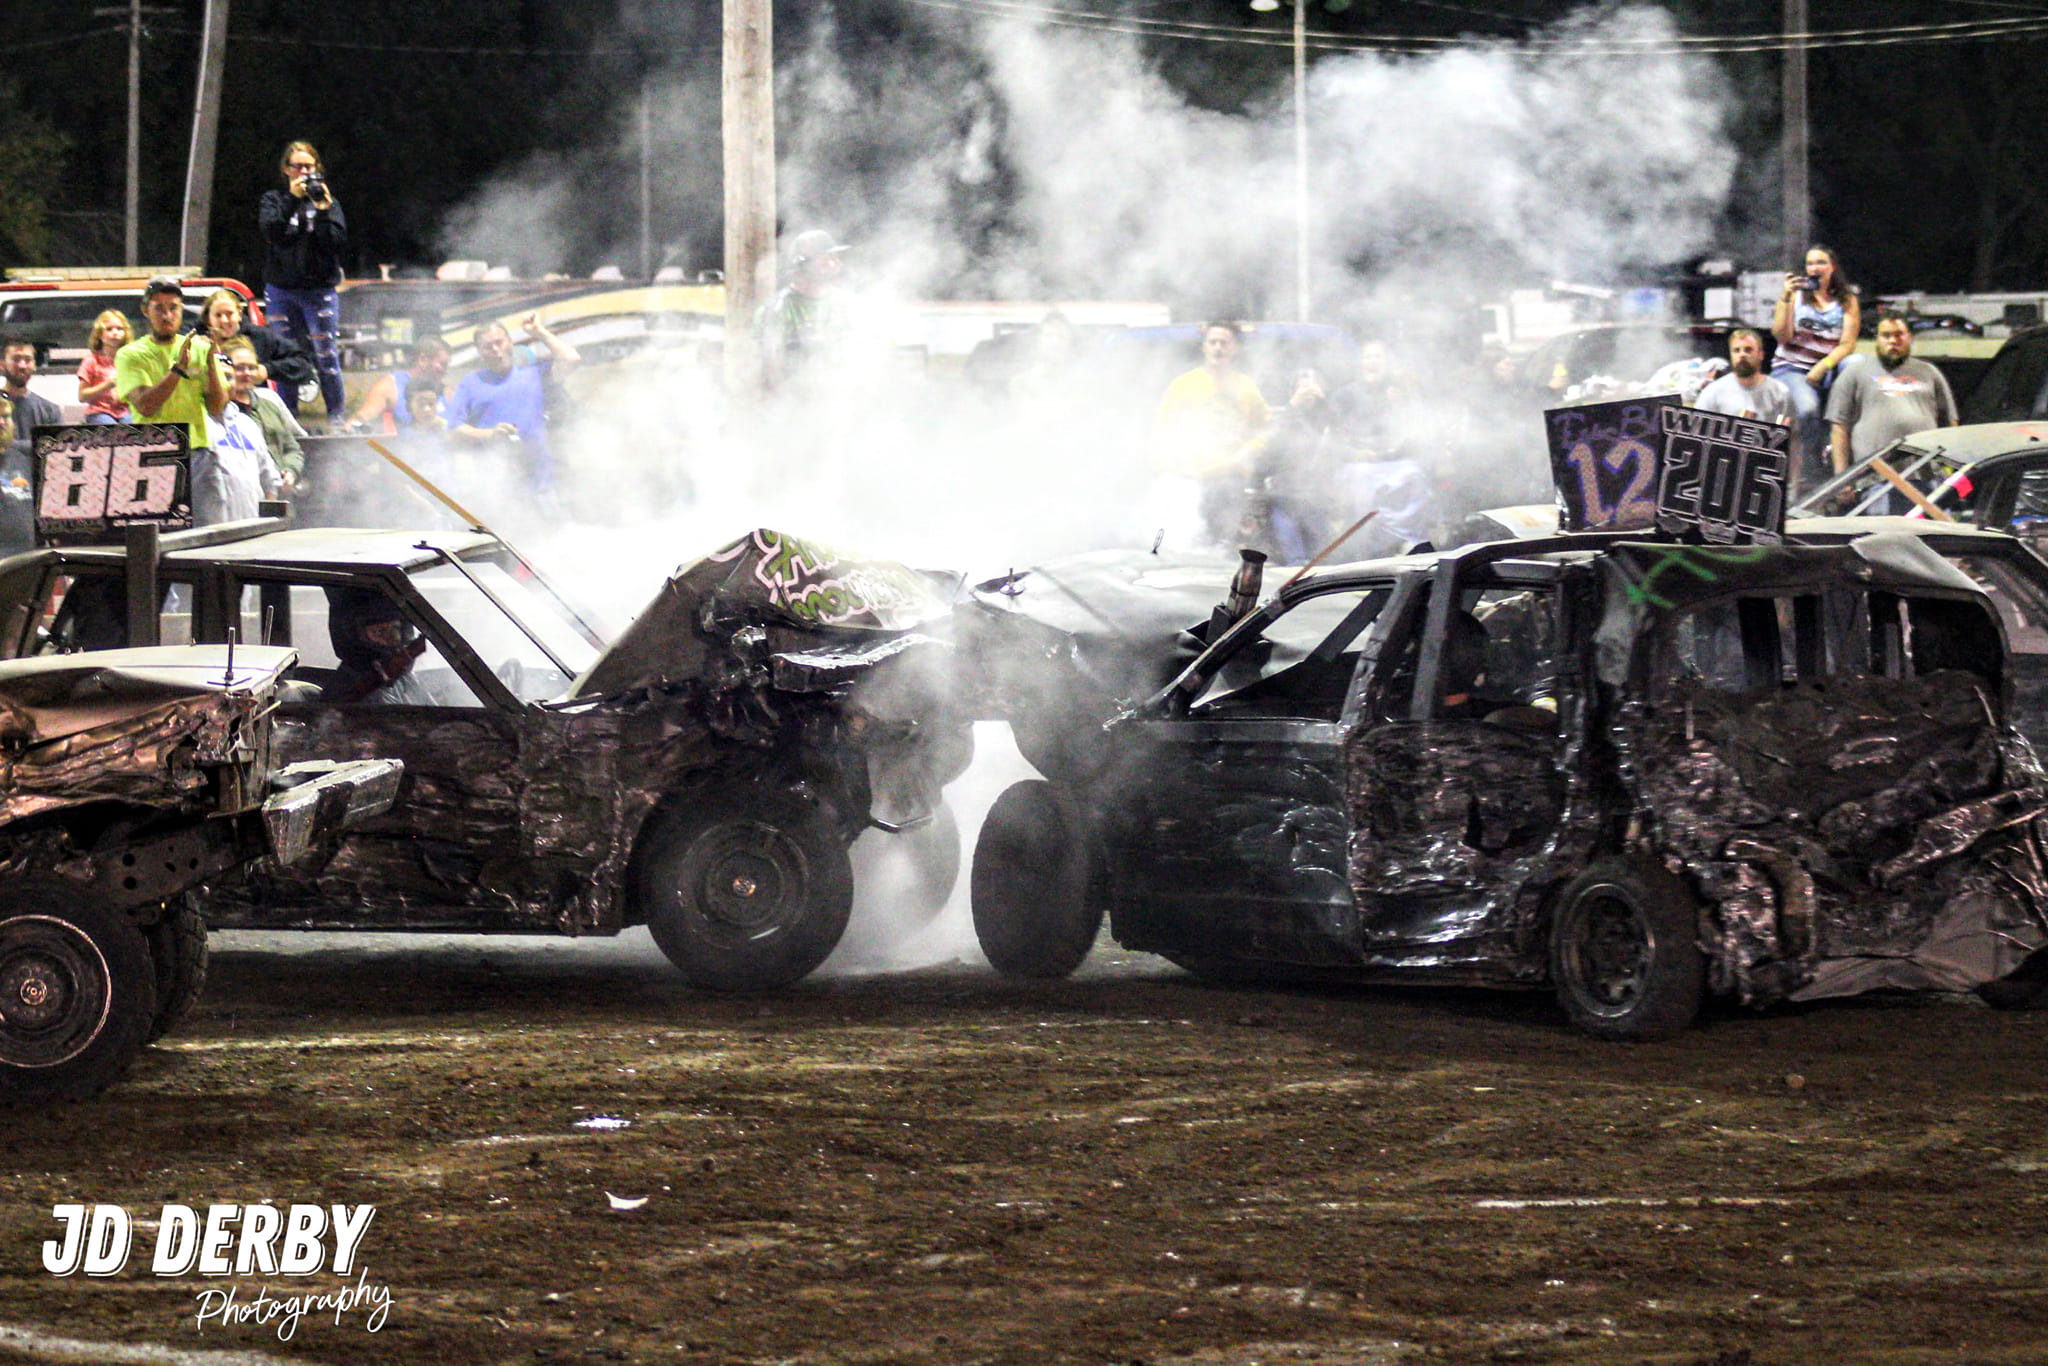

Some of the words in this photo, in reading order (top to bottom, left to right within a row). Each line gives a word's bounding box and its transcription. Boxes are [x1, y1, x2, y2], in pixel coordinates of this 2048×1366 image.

[1661, 405, 1790, 449] WILEY
[38, 442, 183, 520] 86
[1566, 436, 1658, 527] 12
[1657, 433, 1788, 533] 206
